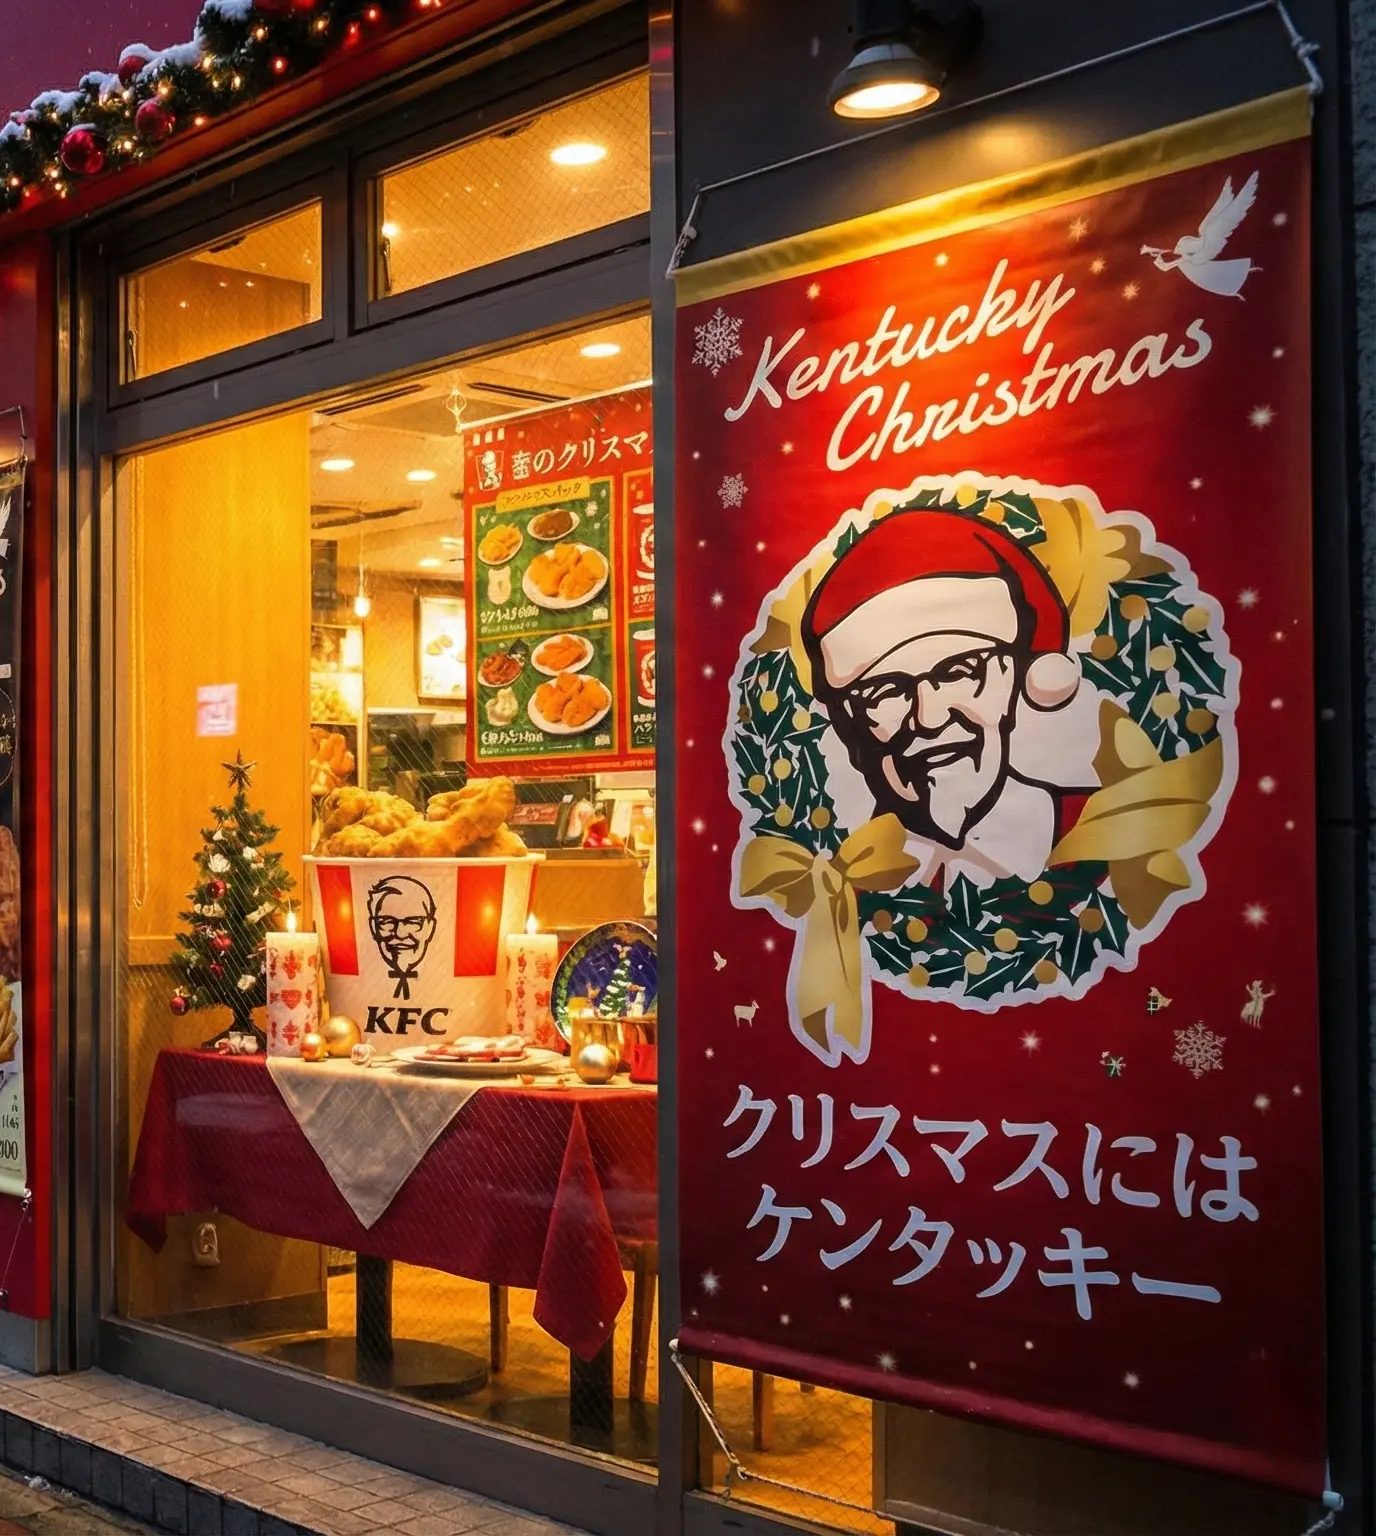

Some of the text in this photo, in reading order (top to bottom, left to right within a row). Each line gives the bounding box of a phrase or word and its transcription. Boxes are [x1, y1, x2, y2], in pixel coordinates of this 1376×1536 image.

[724, 258, 1076, 423] Kentucky
[826, 318, 1213, 472] Christmas
[364, 1006, 450, 1036] KFC
[722, 1084, 1260, 1224] クリスマスには
[746, 1182, 1222, 1321] ケンタッキー
